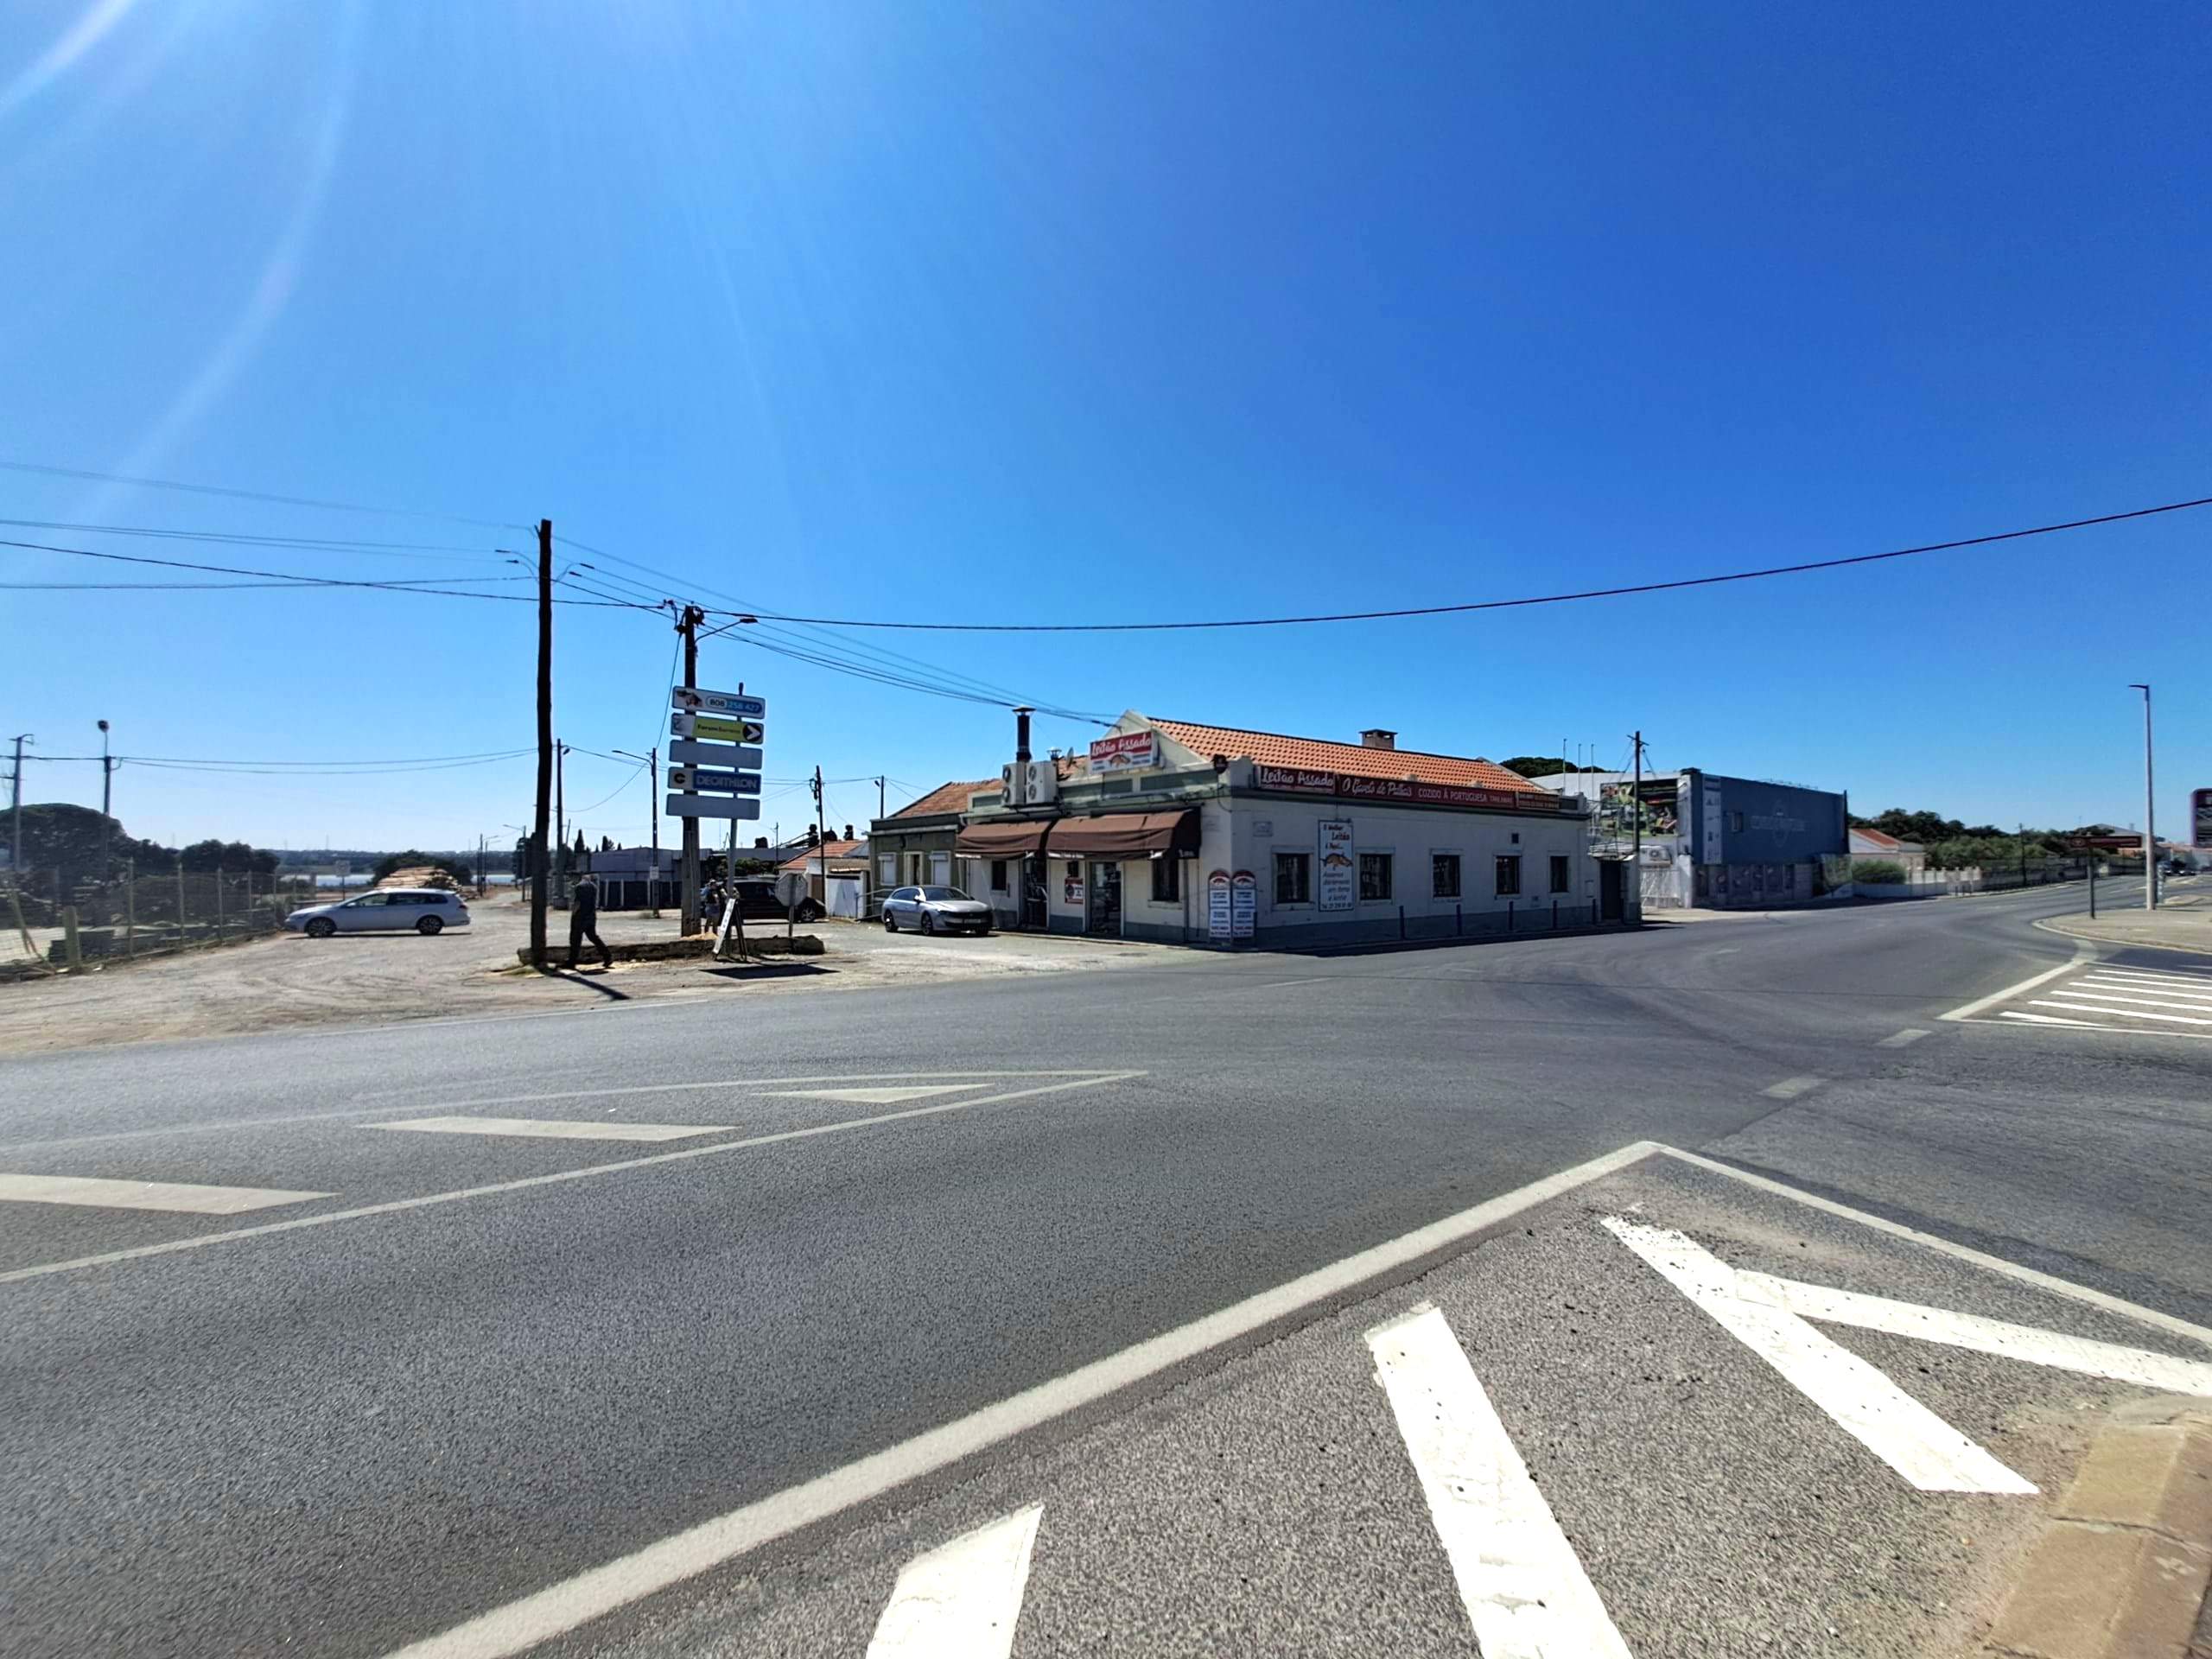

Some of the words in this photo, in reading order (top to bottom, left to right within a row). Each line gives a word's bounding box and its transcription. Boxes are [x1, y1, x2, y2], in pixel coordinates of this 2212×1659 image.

[1119, 734, 1151, 750] Assado
[696, 775, 758, 789] DECATHLON
[1262, 766, 1294, 784] Leitão
[1297, 771, 1334, 786] Assado
[1418, 787, 1441, 799] COZIDO
[1450, 791, 1488, 803] PORTUGUESA
